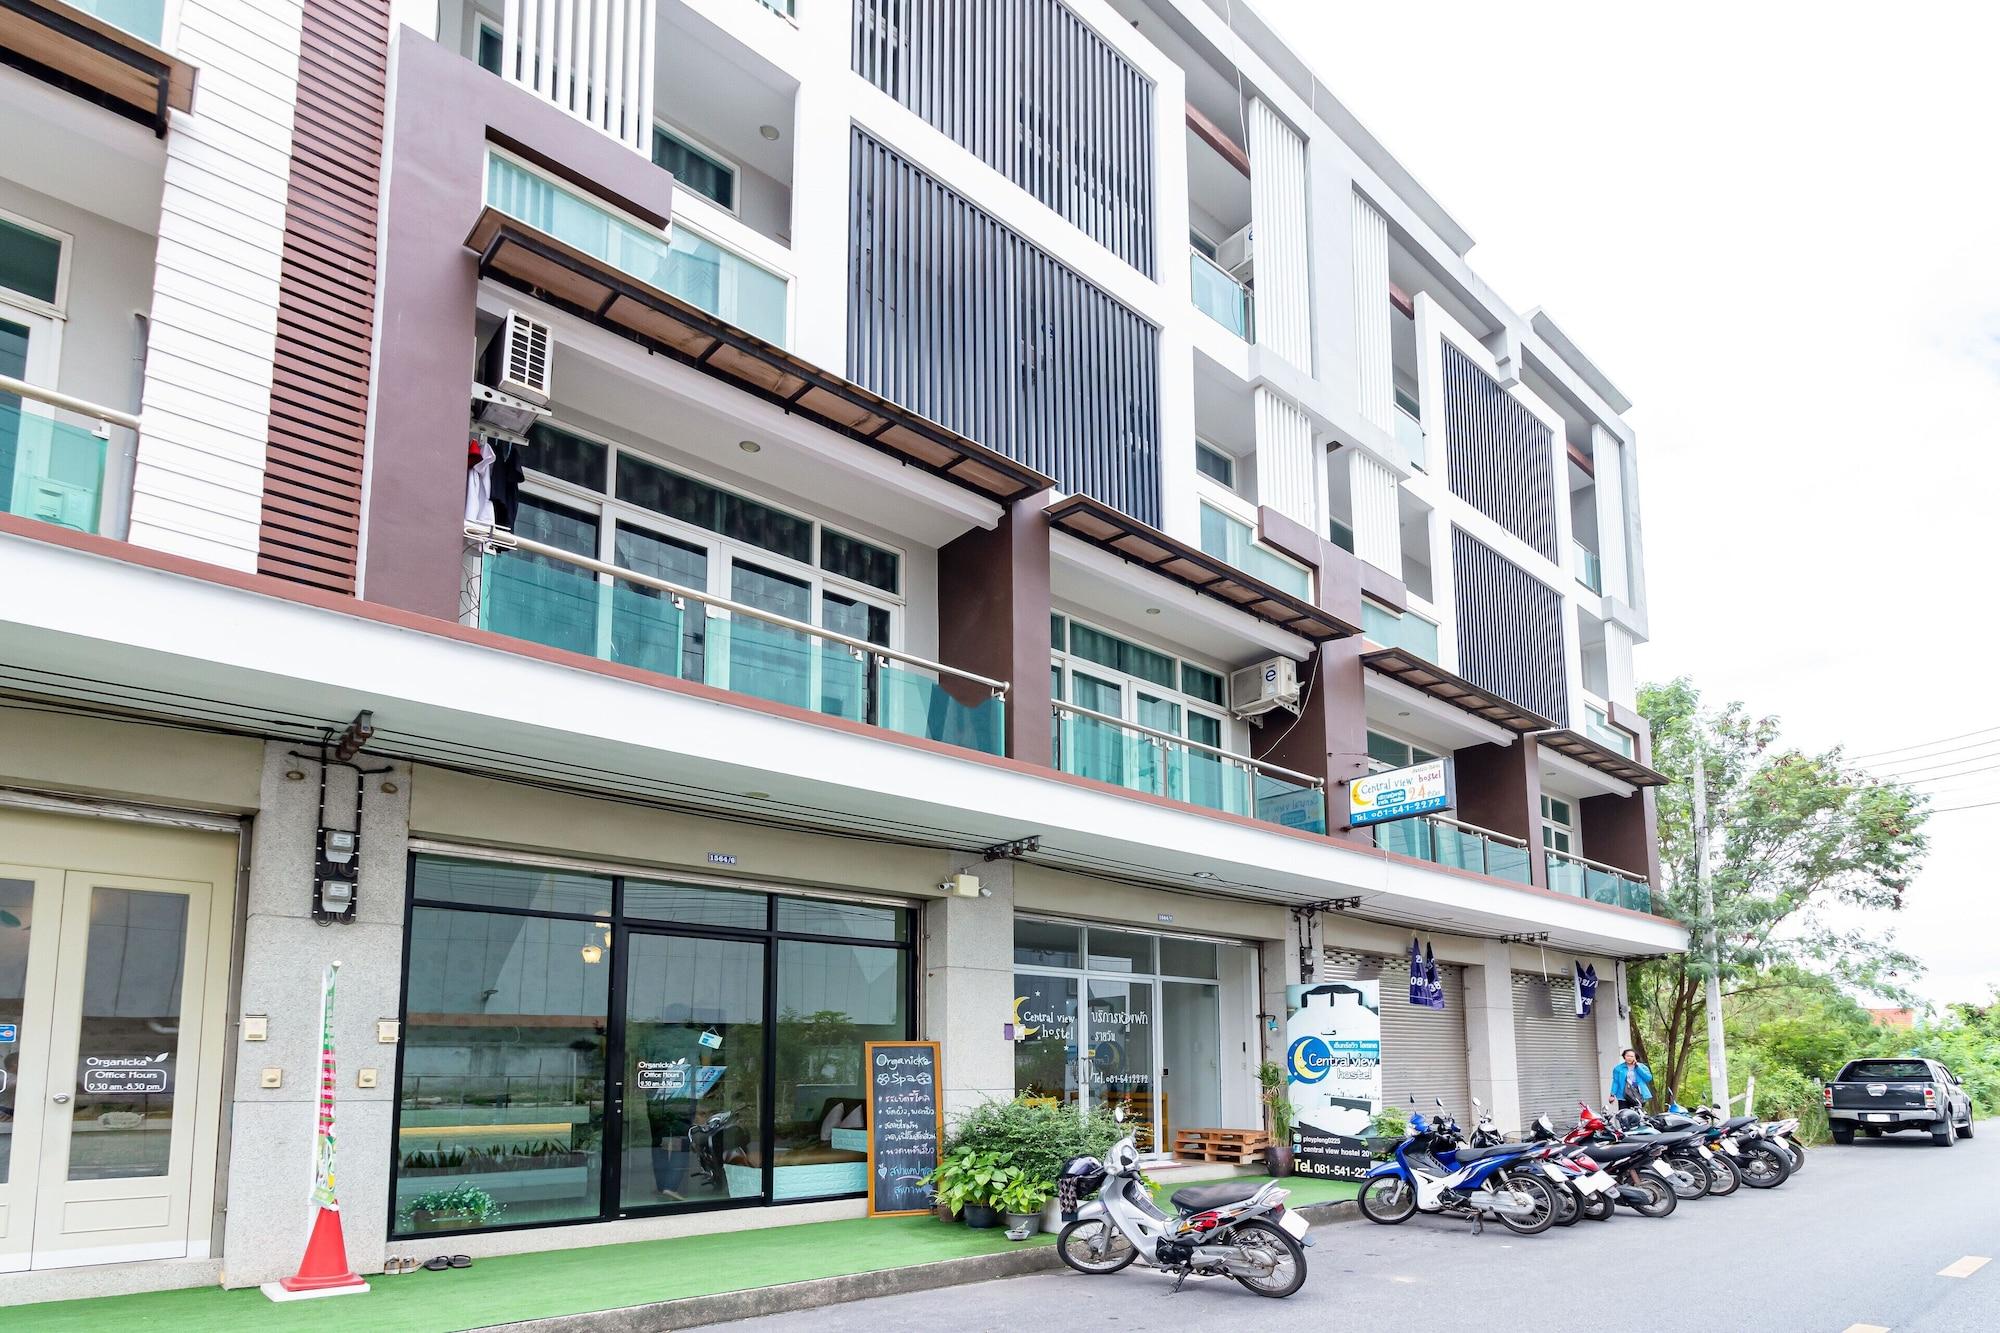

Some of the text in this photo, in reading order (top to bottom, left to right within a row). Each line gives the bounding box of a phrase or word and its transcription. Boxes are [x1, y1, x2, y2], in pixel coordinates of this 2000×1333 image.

[1361, 770, 1441, 795] Central view hostel
[1408, 785, 1426, 800] 24
[1371, 798, 1441, 818] 081-541-2272
[1023, 1011, 1076, 1023] Central view
[1091, 1010, 1148, 1025] บริการห้องพัก
[1042, 1024, 1074, 1040] hostel
[86, 1057, 147, 1067] Organicka
[638, 1061, 673, 1069] Organicka
[876, 1053, 932, 1070] Organicka
[1309, 1053, 1377, 1067] Central view
[95, 1071, 158, 1079] Office Hours
[890, 1071, 916, 1086] Spa
[1337, 1068, 1372, 1079] hostel
[88, 1083, 108, 1091] 9.30
[1303, 1146, 1324, 1154] central
[1325, 1147, 1339, 1155] view
[1341, 1148, 1360, 1156] hostel
[1293, 1158, 1313, 1173] Tel.
